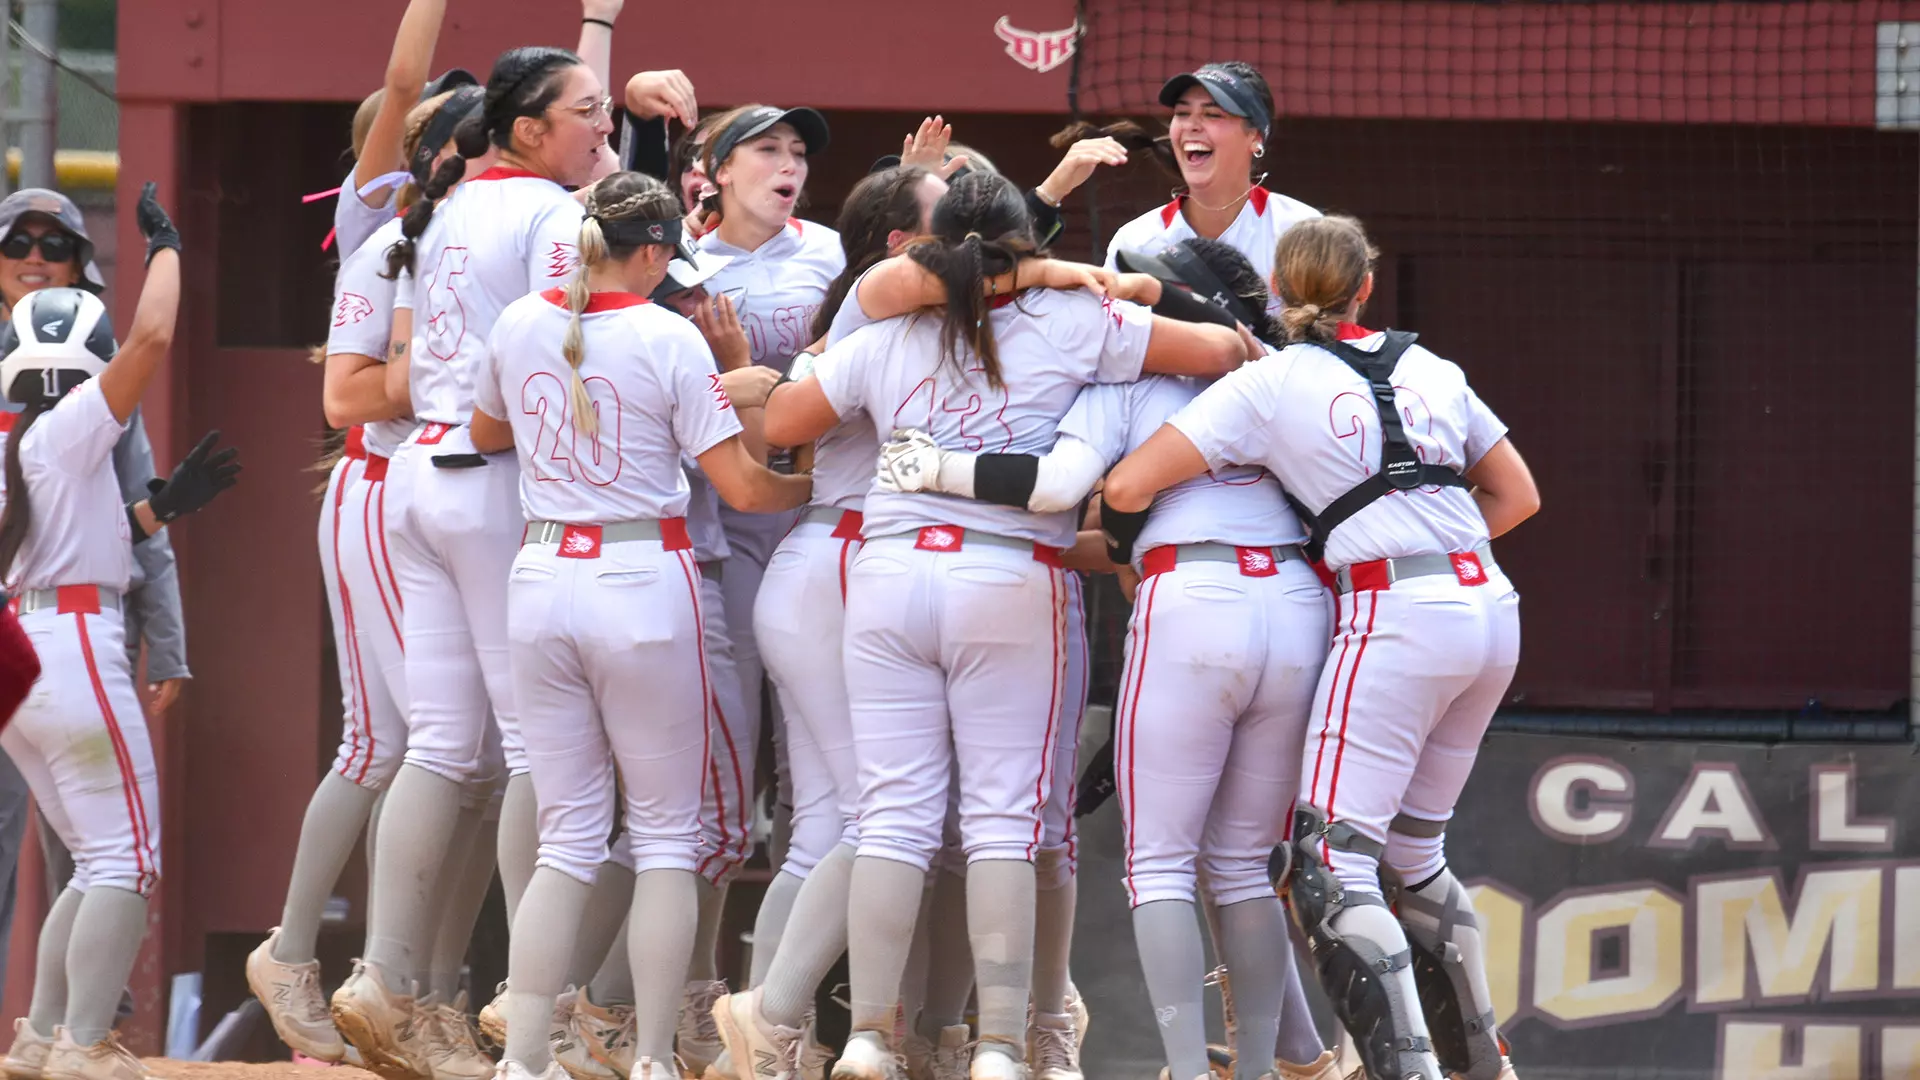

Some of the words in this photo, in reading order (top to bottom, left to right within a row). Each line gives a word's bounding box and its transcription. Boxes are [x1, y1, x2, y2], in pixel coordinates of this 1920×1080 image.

[40, 367, 61, 397] 1
[521, 371, 622, 486] 20
[1387, 460, 1416, 469] EASTON
[1528, 754, 1896, 851] CAL
